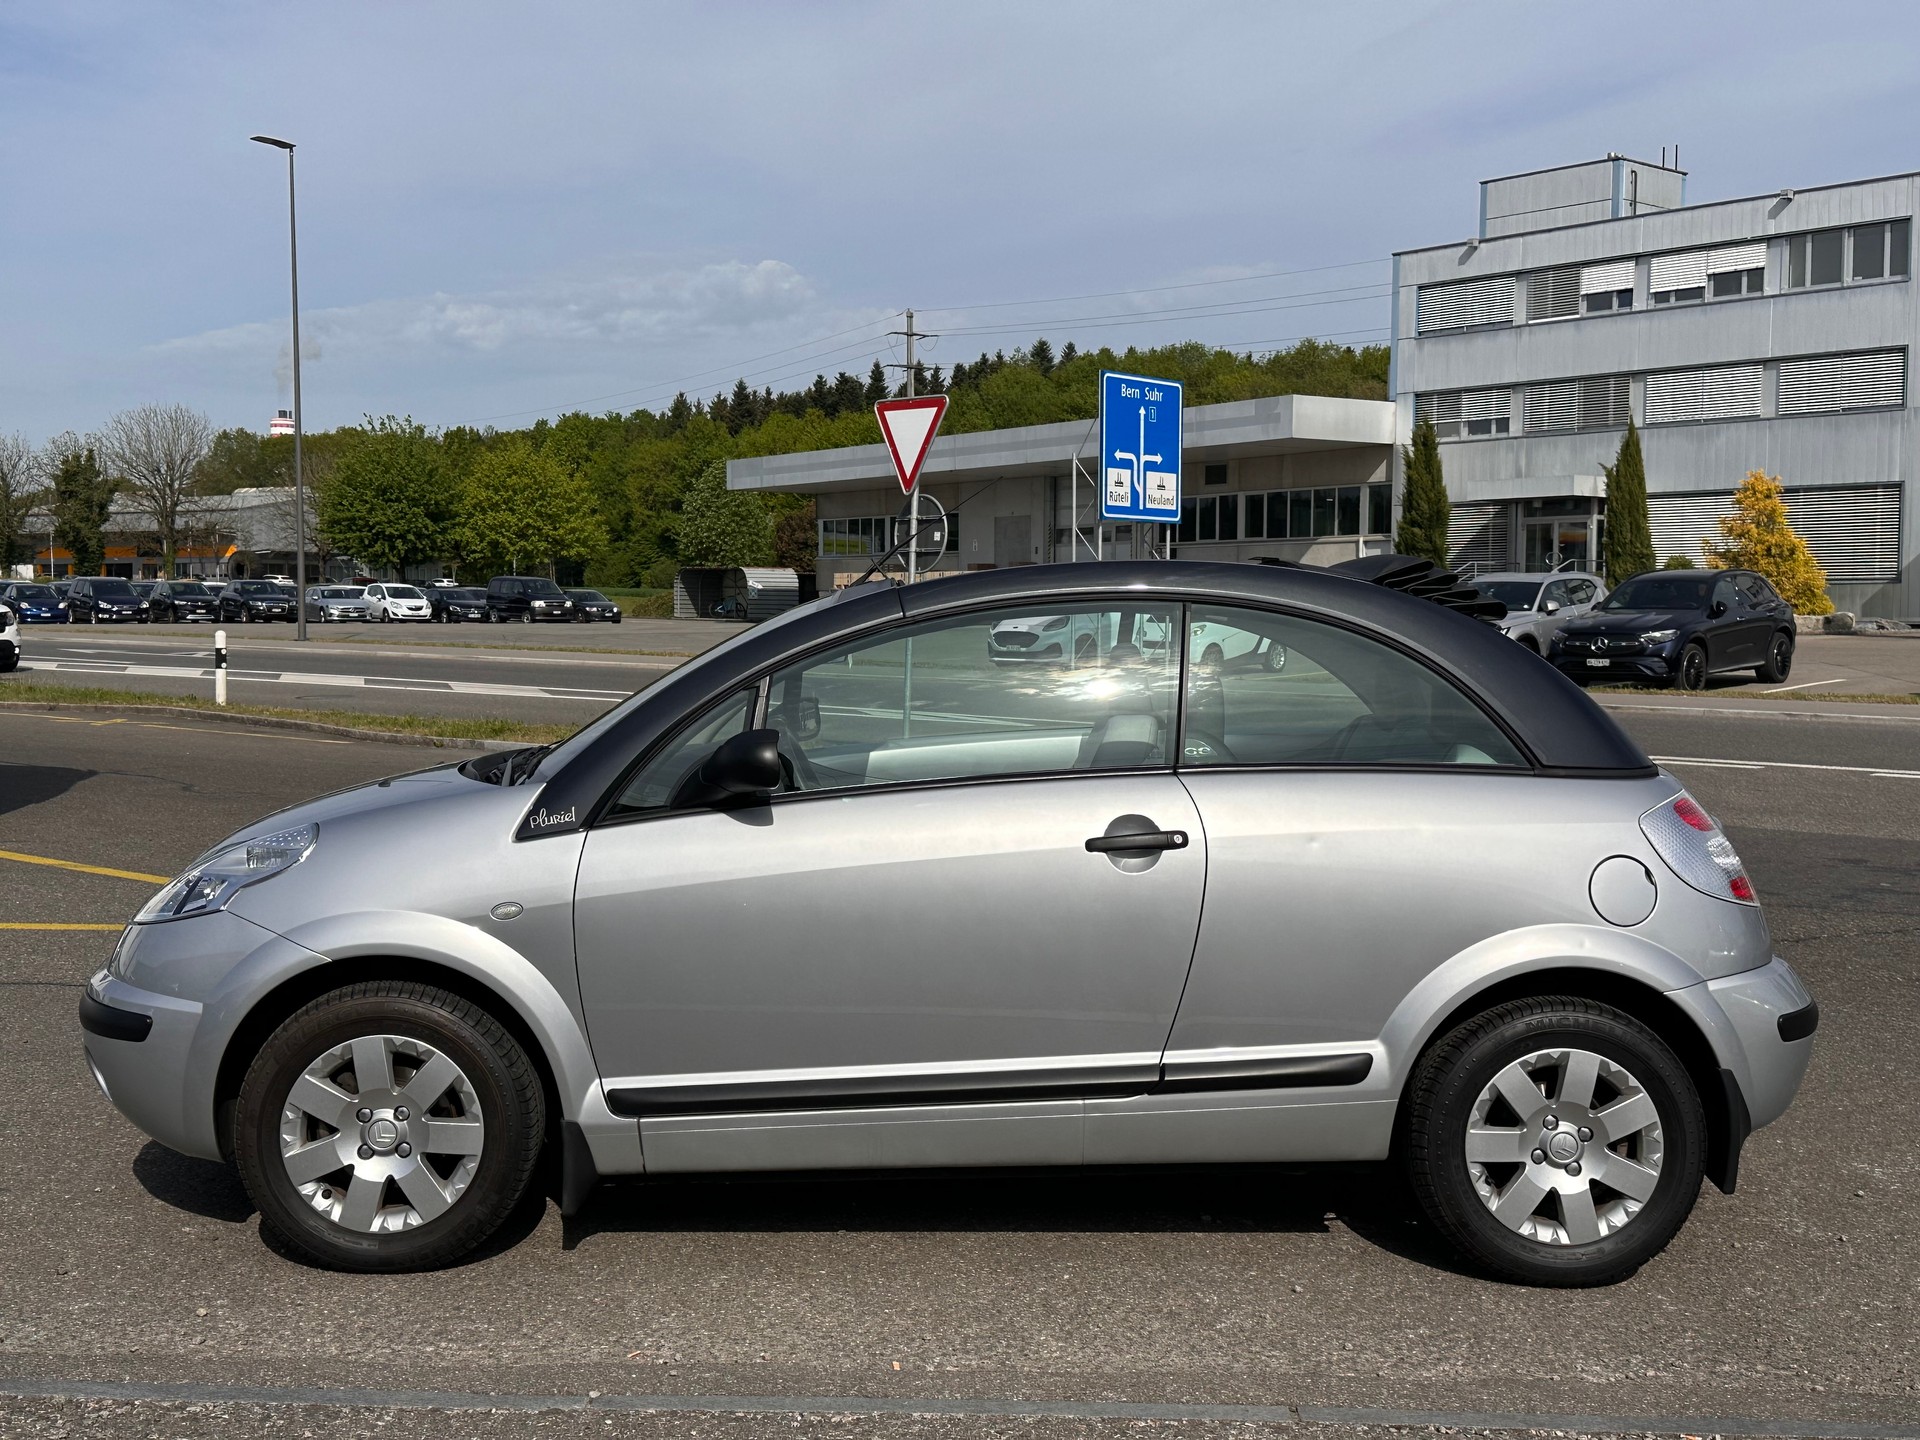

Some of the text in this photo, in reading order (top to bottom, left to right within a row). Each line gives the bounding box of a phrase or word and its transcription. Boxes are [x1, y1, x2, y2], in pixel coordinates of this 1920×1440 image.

[1121, 384, 1164, 402] Bern Suhr
[1147, 494, 1175, 507] Neuland
